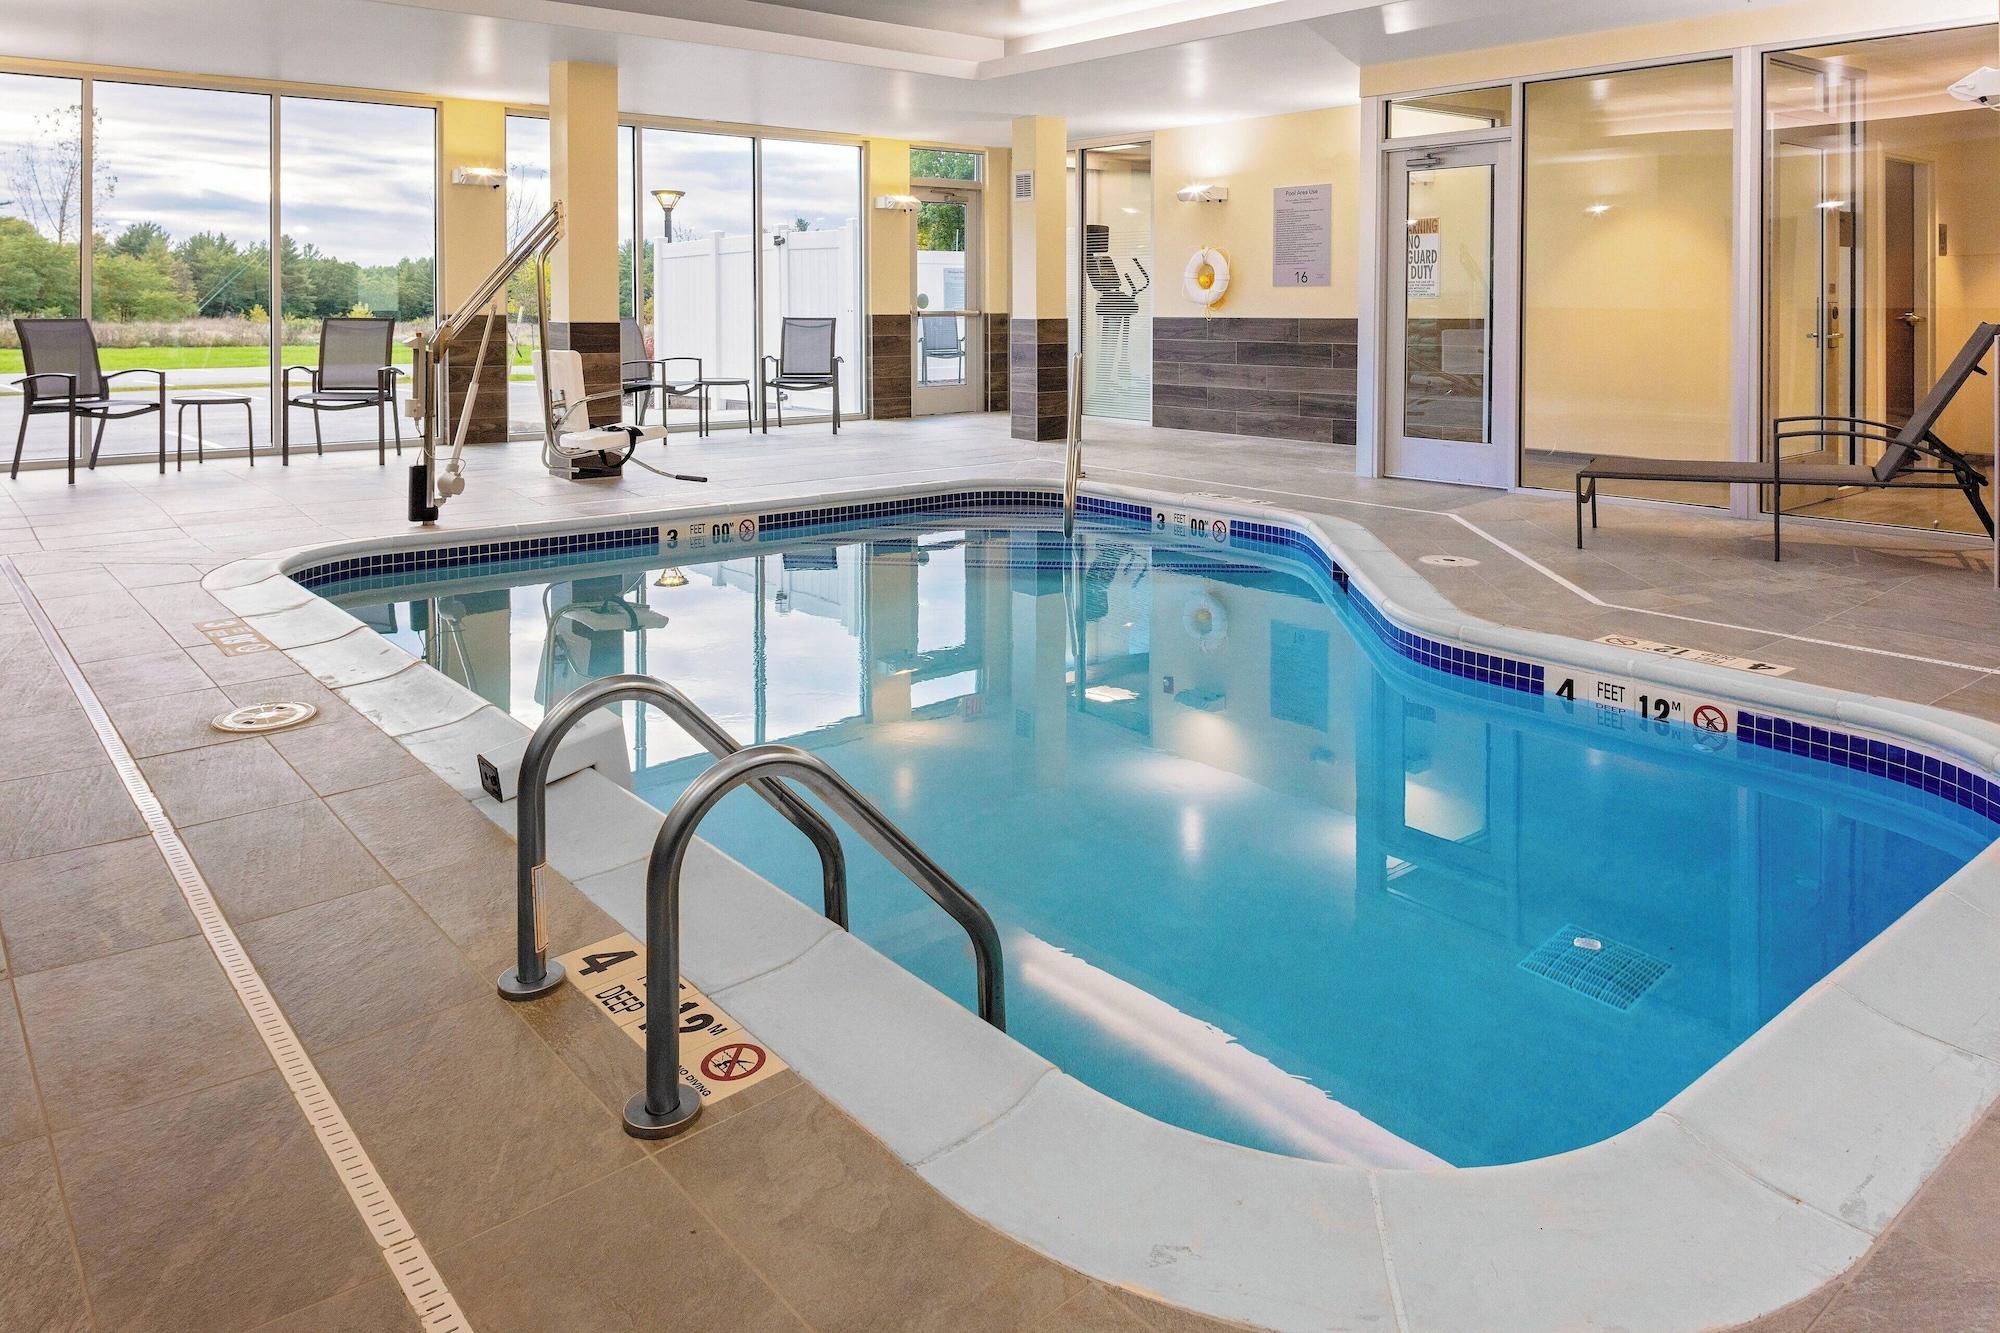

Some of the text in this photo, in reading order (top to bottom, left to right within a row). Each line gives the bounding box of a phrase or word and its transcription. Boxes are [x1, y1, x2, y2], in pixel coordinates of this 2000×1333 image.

[1408, 235, 1420, 249] NO
[1294, 272, 1308, 283] 16
[1410, 265, 1434, 280] DUTY
[1173, 513, 1186, 524] FEET
[667, 529, 678, 541] 3
[689, 523, 706, 535] FEET
[1555, 678, 1576, 701] 4
[1597, 681, 1626, 703] FEET
[578, 950, 638, 976] 4
[595, 984, 644, 1015] DEEP
[685, 1075, 711, 1097] DIVING
